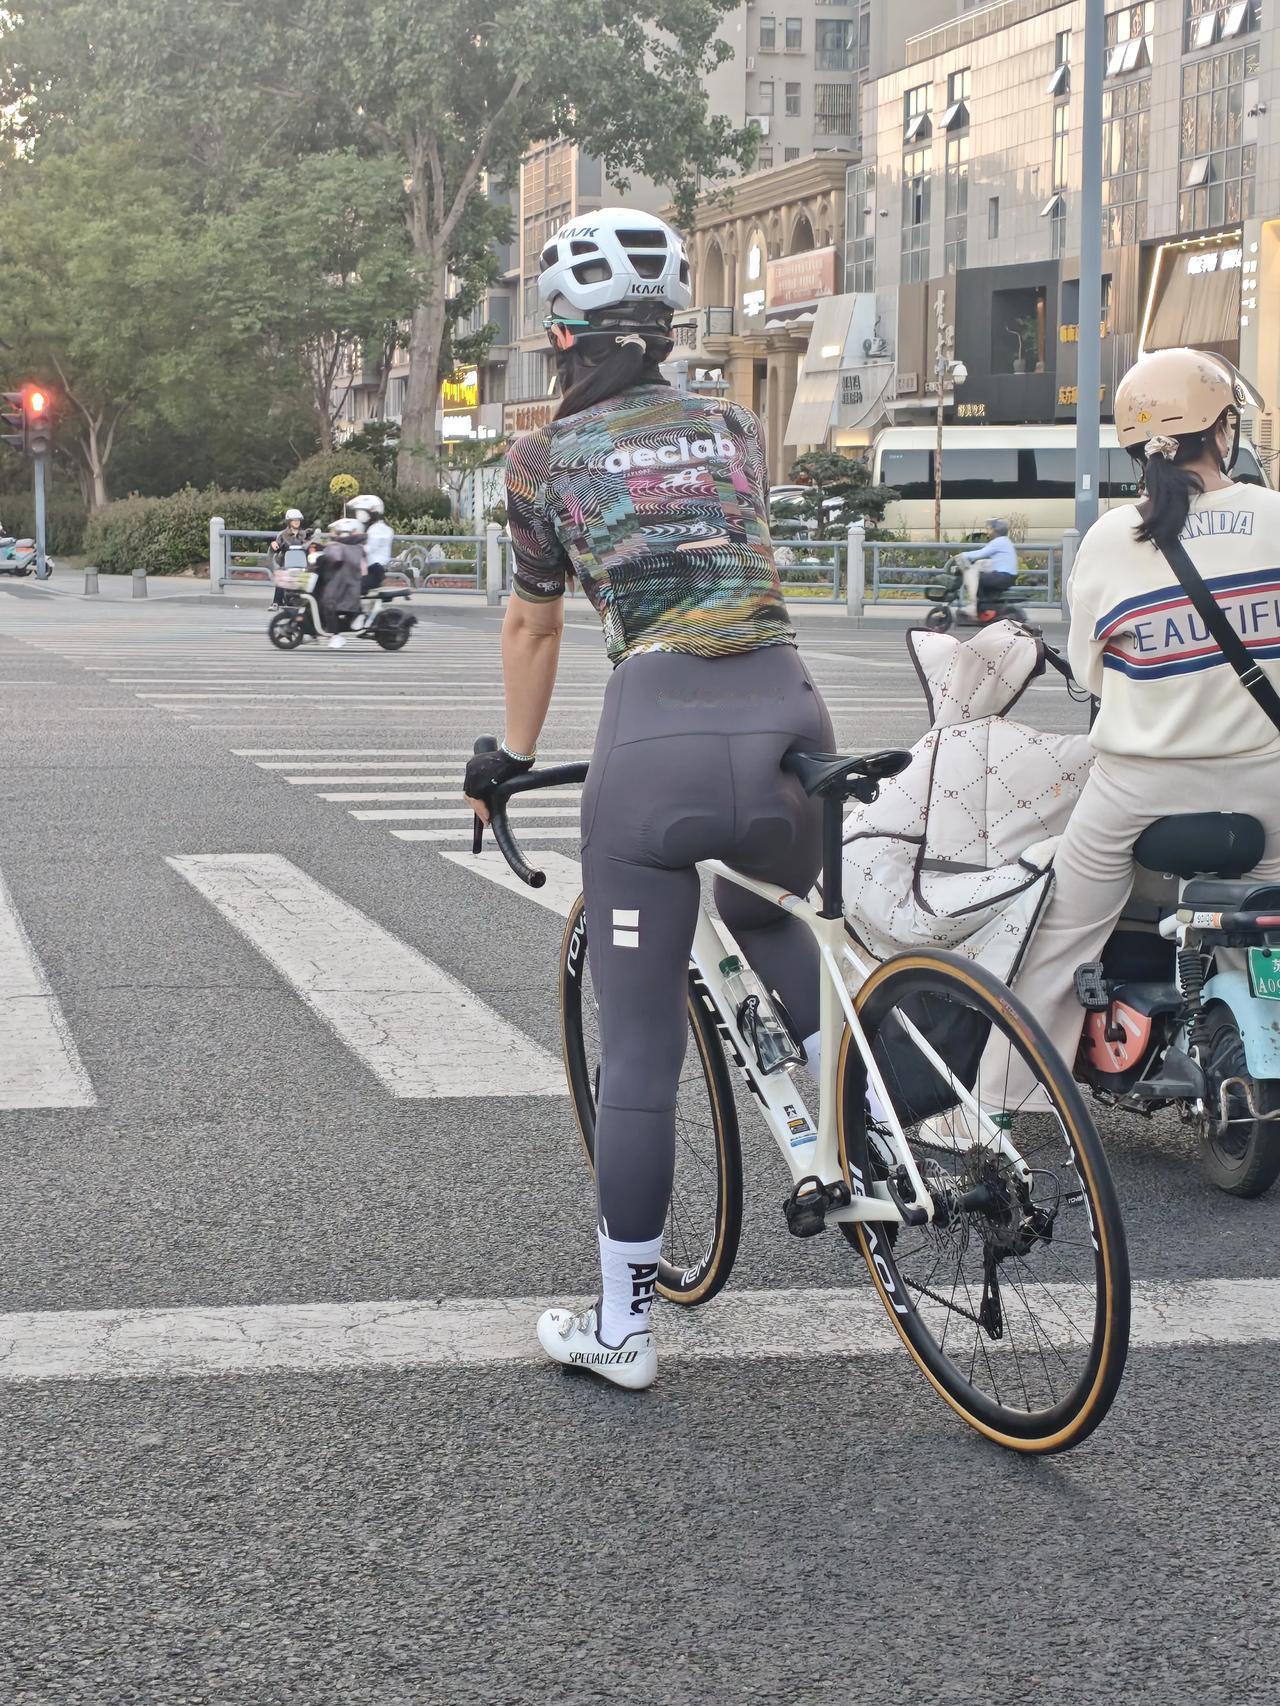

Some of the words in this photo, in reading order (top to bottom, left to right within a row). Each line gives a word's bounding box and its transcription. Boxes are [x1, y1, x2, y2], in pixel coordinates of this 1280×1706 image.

[559, 227, 600, 239] KASK
[632, 284, 665, 295] KASK
[568, 1350, 639, 1366] SPECIALIZED
